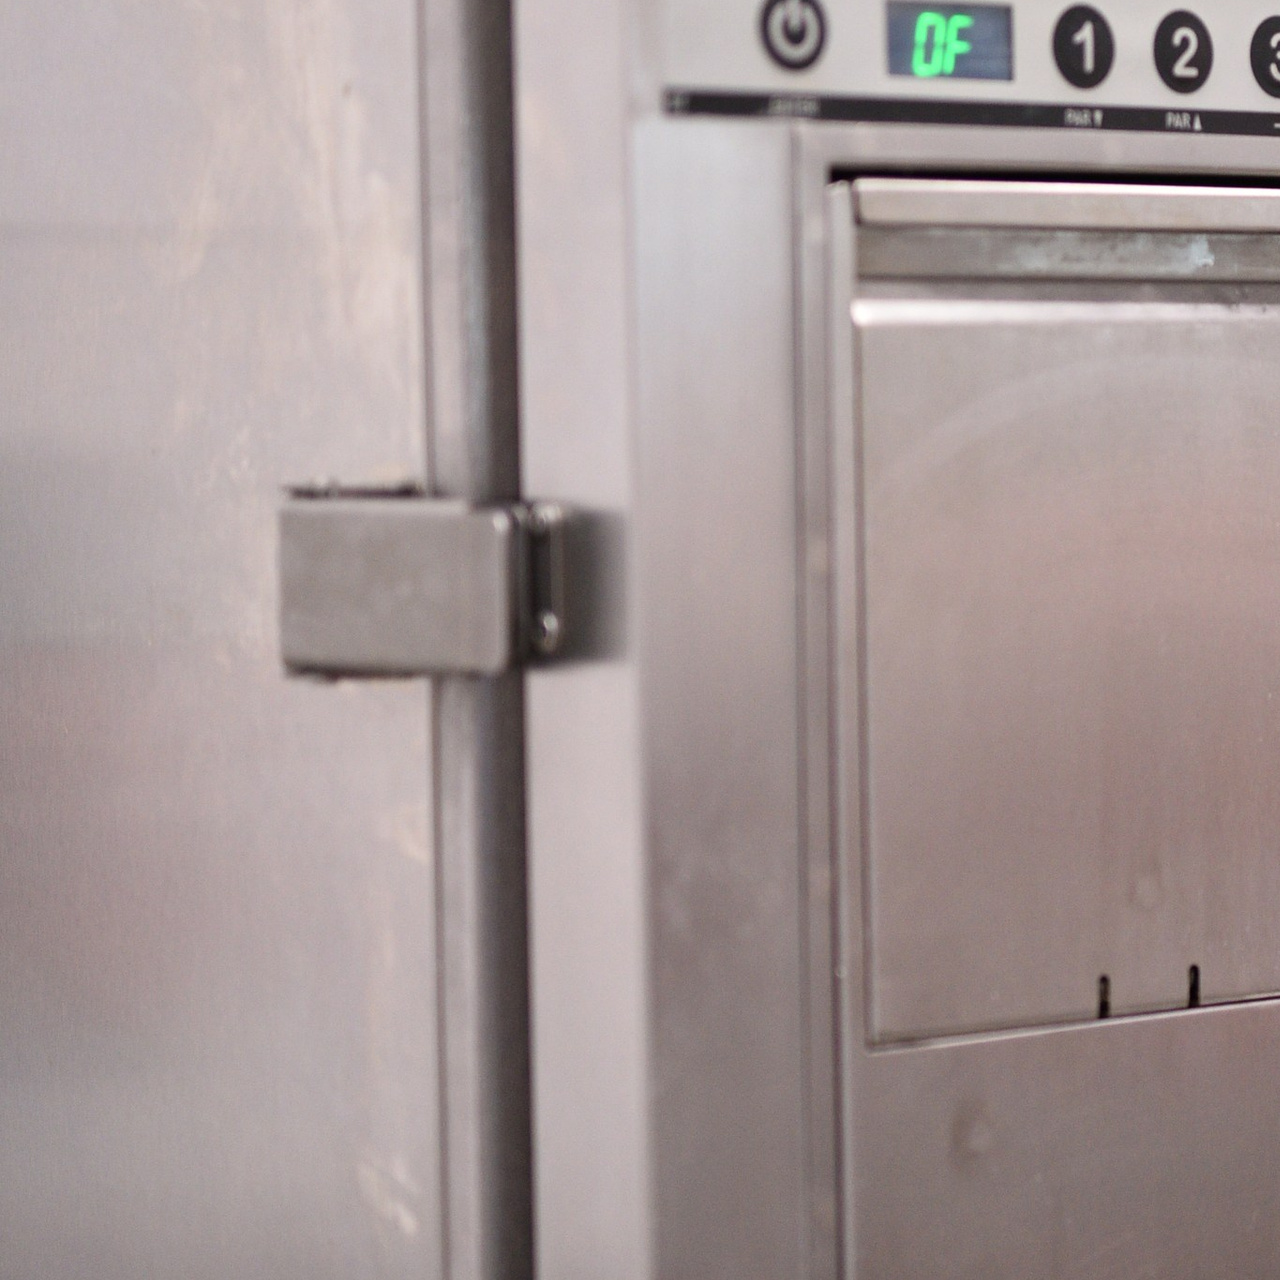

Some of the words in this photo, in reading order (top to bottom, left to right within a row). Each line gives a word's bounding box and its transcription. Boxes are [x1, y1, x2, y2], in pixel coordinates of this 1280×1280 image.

[1072, 19, 1095, 75] 1
[1171, 25, 1199, 79] 2
[1164, 110, 1192, 130] PAR
